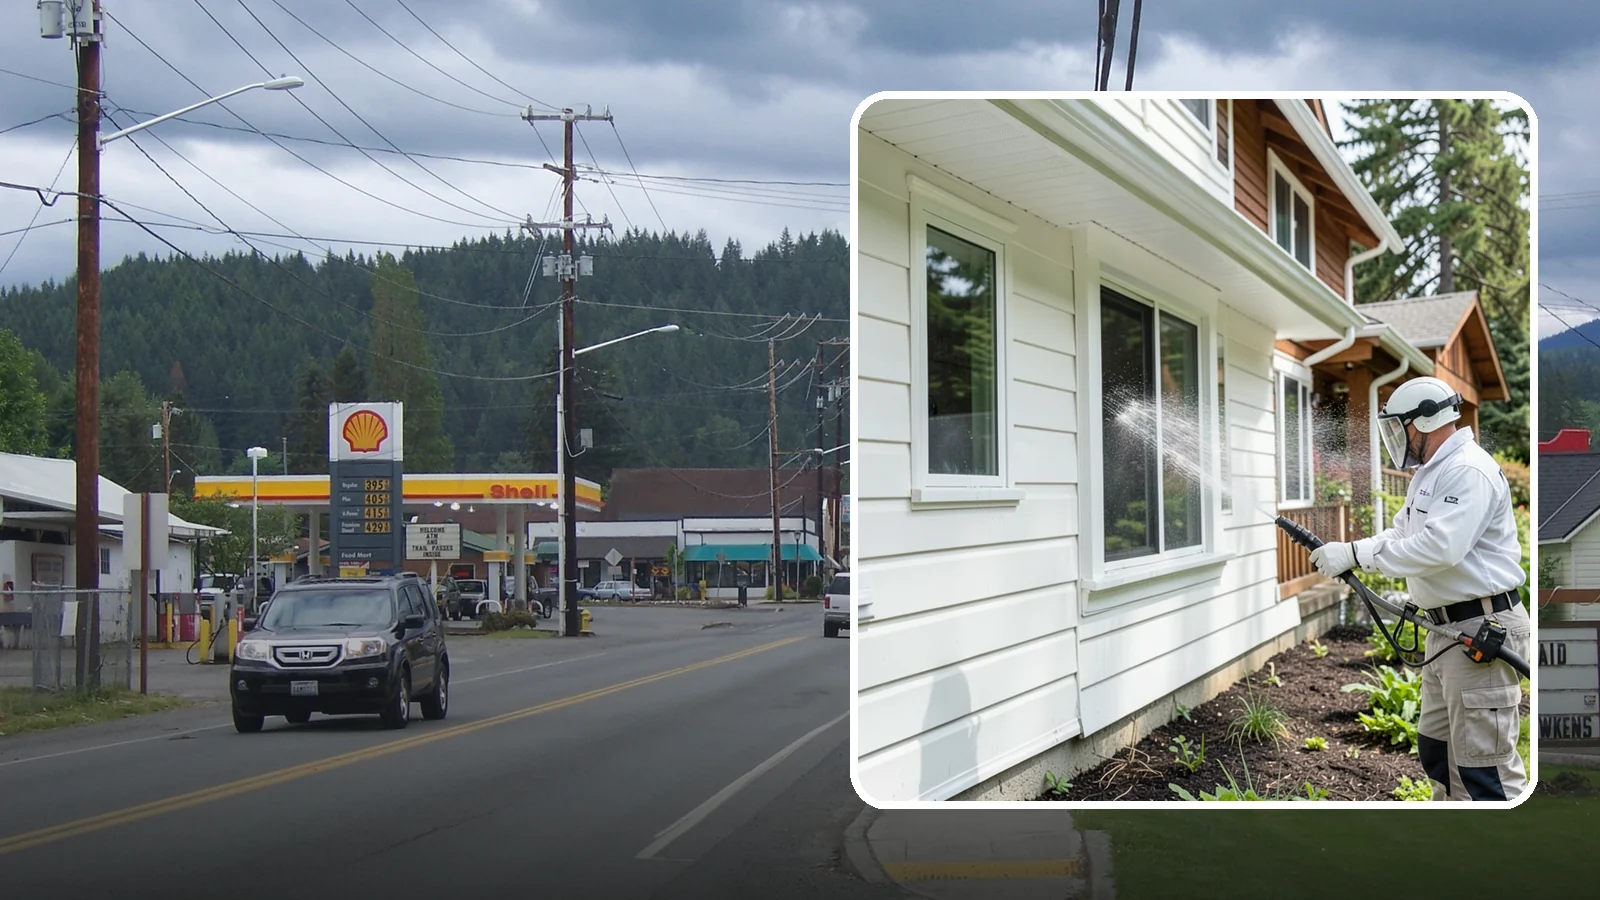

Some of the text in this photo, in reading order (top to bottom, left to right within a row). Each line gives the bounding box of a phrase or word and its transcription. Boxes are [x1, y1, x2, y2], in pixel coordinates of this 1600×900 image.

[366, 480, 384, 490] 395
[490, 484, 547, 499] Shell
[366, 494, 384, 504] 405
[366, 508, 383, 518] 415
[366, 522, 384, 533] 429
